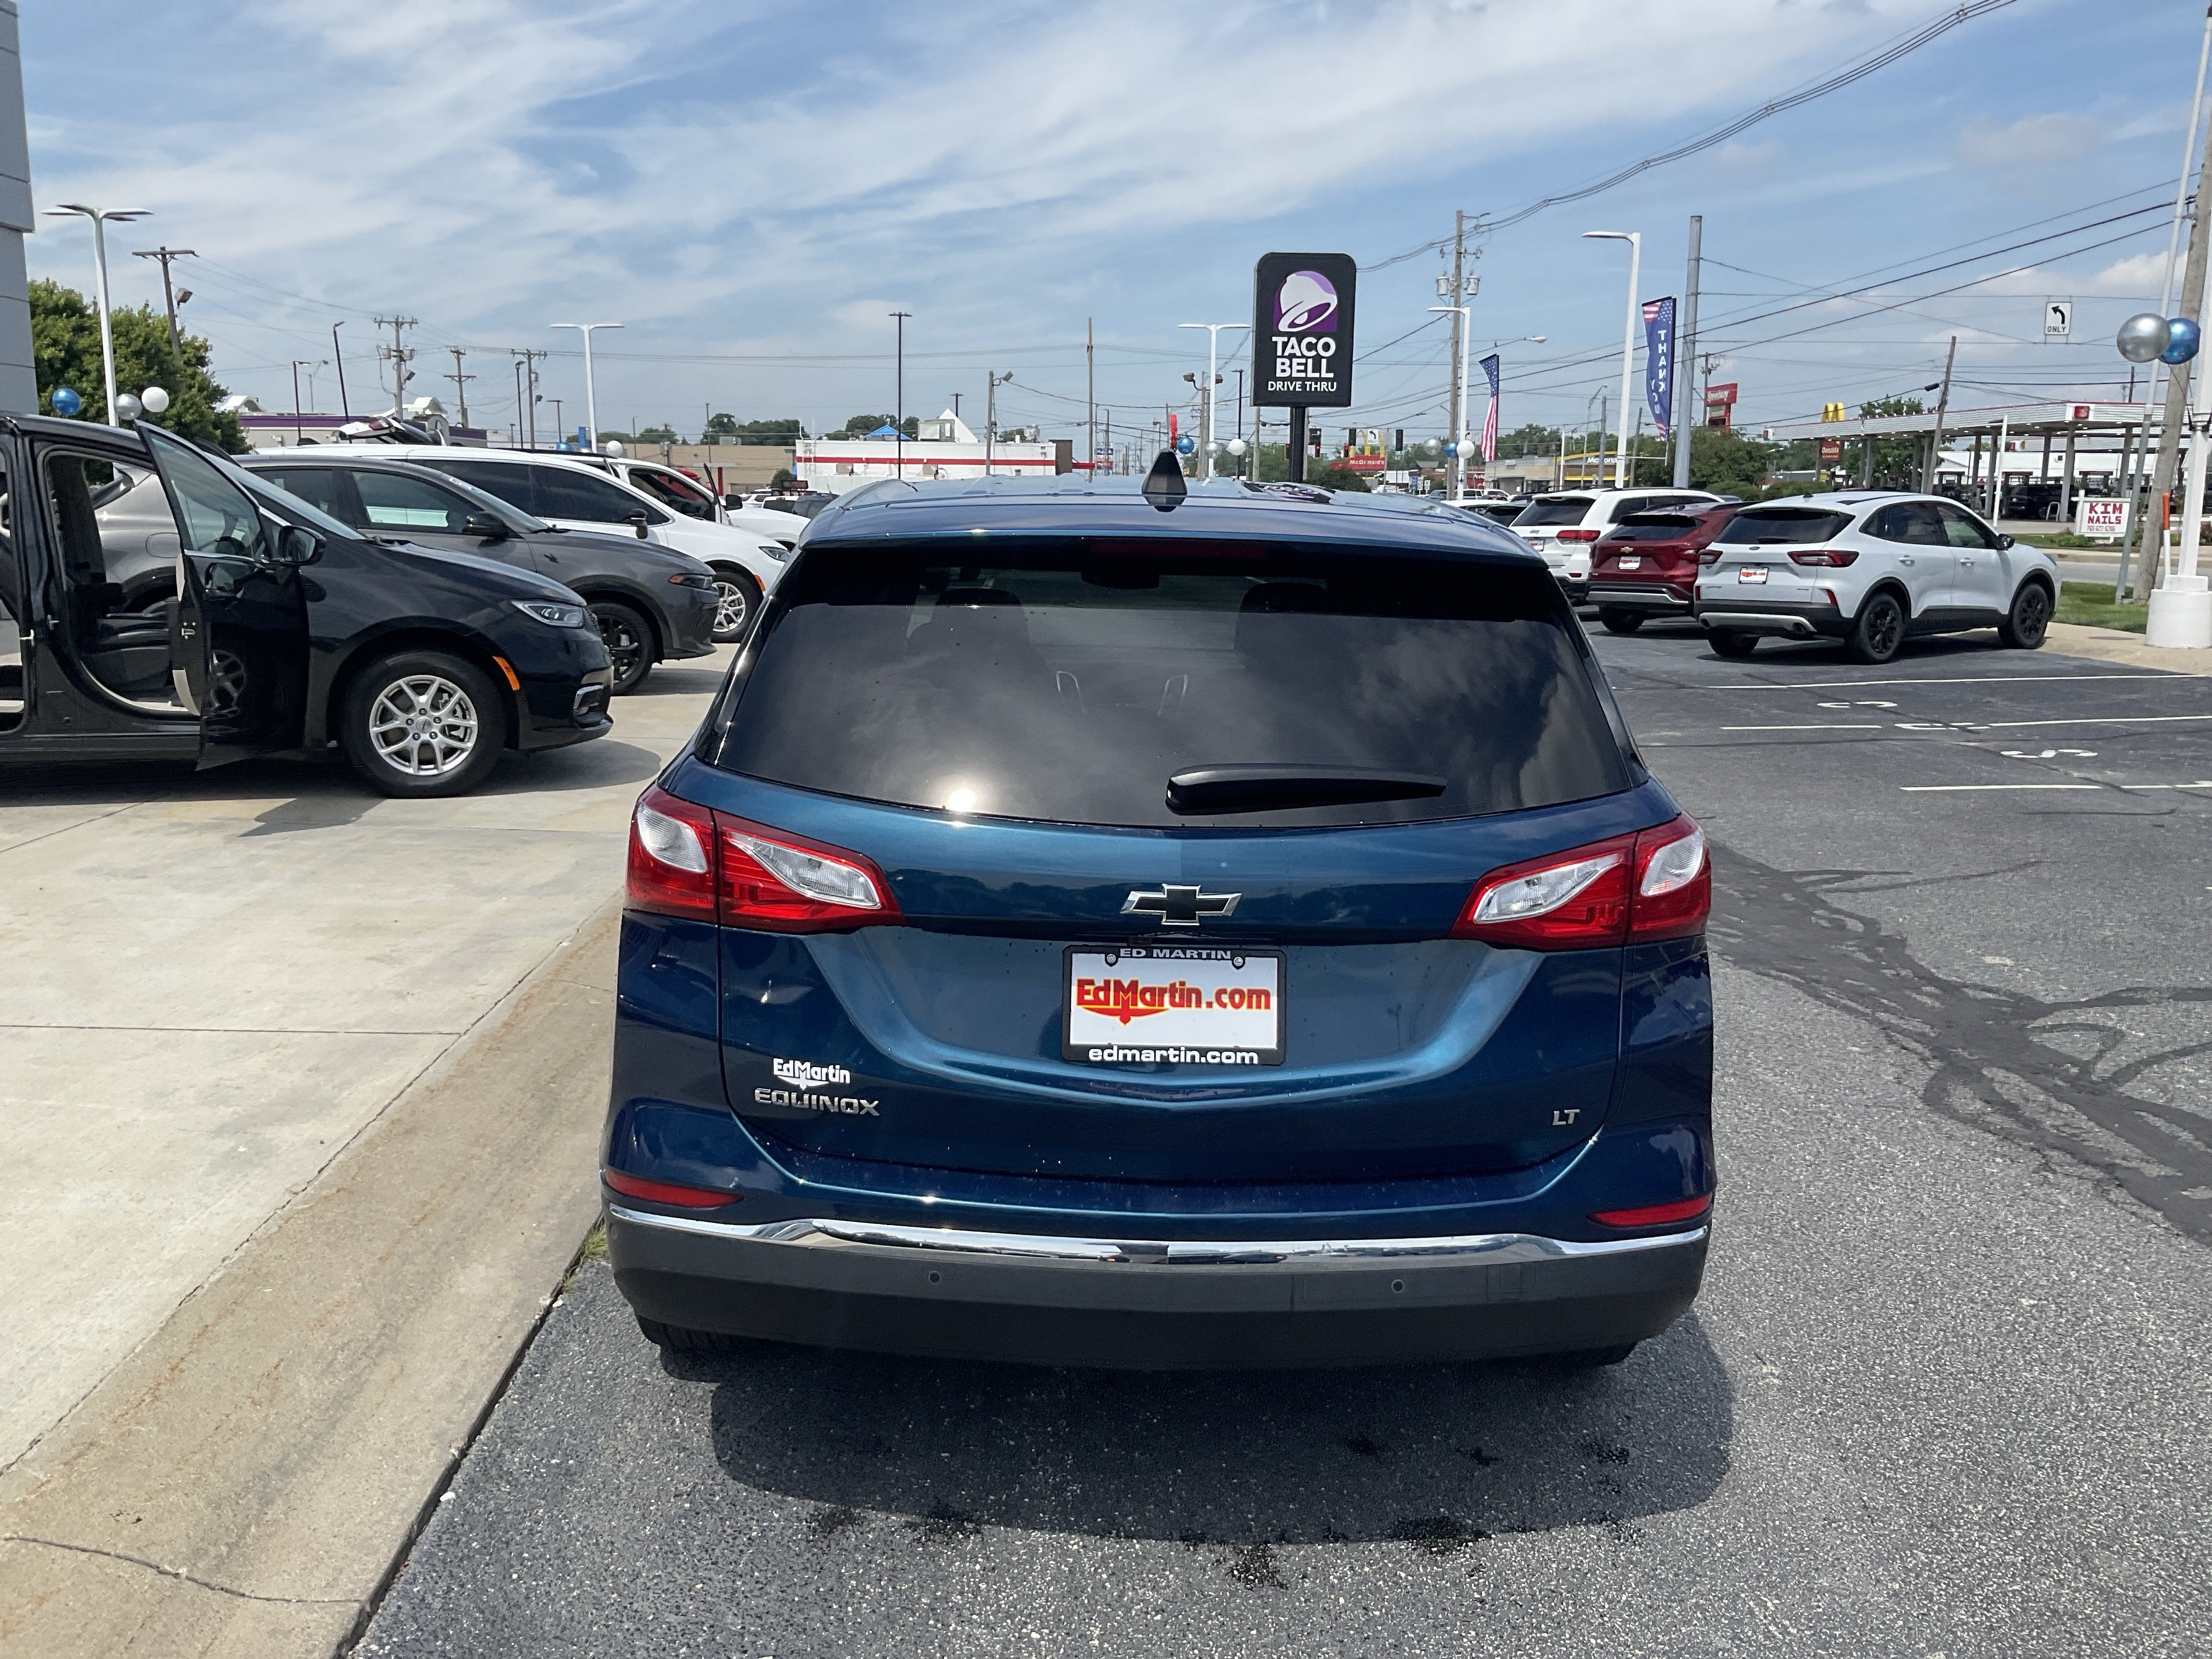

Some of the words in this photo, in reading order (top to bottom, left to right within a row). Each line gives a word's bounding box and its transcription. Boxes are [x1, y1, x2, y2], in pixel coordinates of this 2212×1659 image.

[1272, 336, 1336, 357] TACO
[1276, 358, 1334, 378] BELL
[1268, 381, 1302, 391] DRIVE
[1305, 381, 1337, 392] THRU
[2089, 503, 2123, 515] KIM
[2087, 516, 2121, 524] NAILS
[1120, 948, 1146, 957] ED
[1153, 949, 1231, 959] MARTIN
[1076, 978, 1271, 1013] EdMartin.com
[1088, 1045, 1259, 1064] edmartin.com
[773, 1057, 851, 1086] EdMartin
[754, 1087, 880, 1116] EQUINOX
[1553, 1109, 1581, 1126] LT
